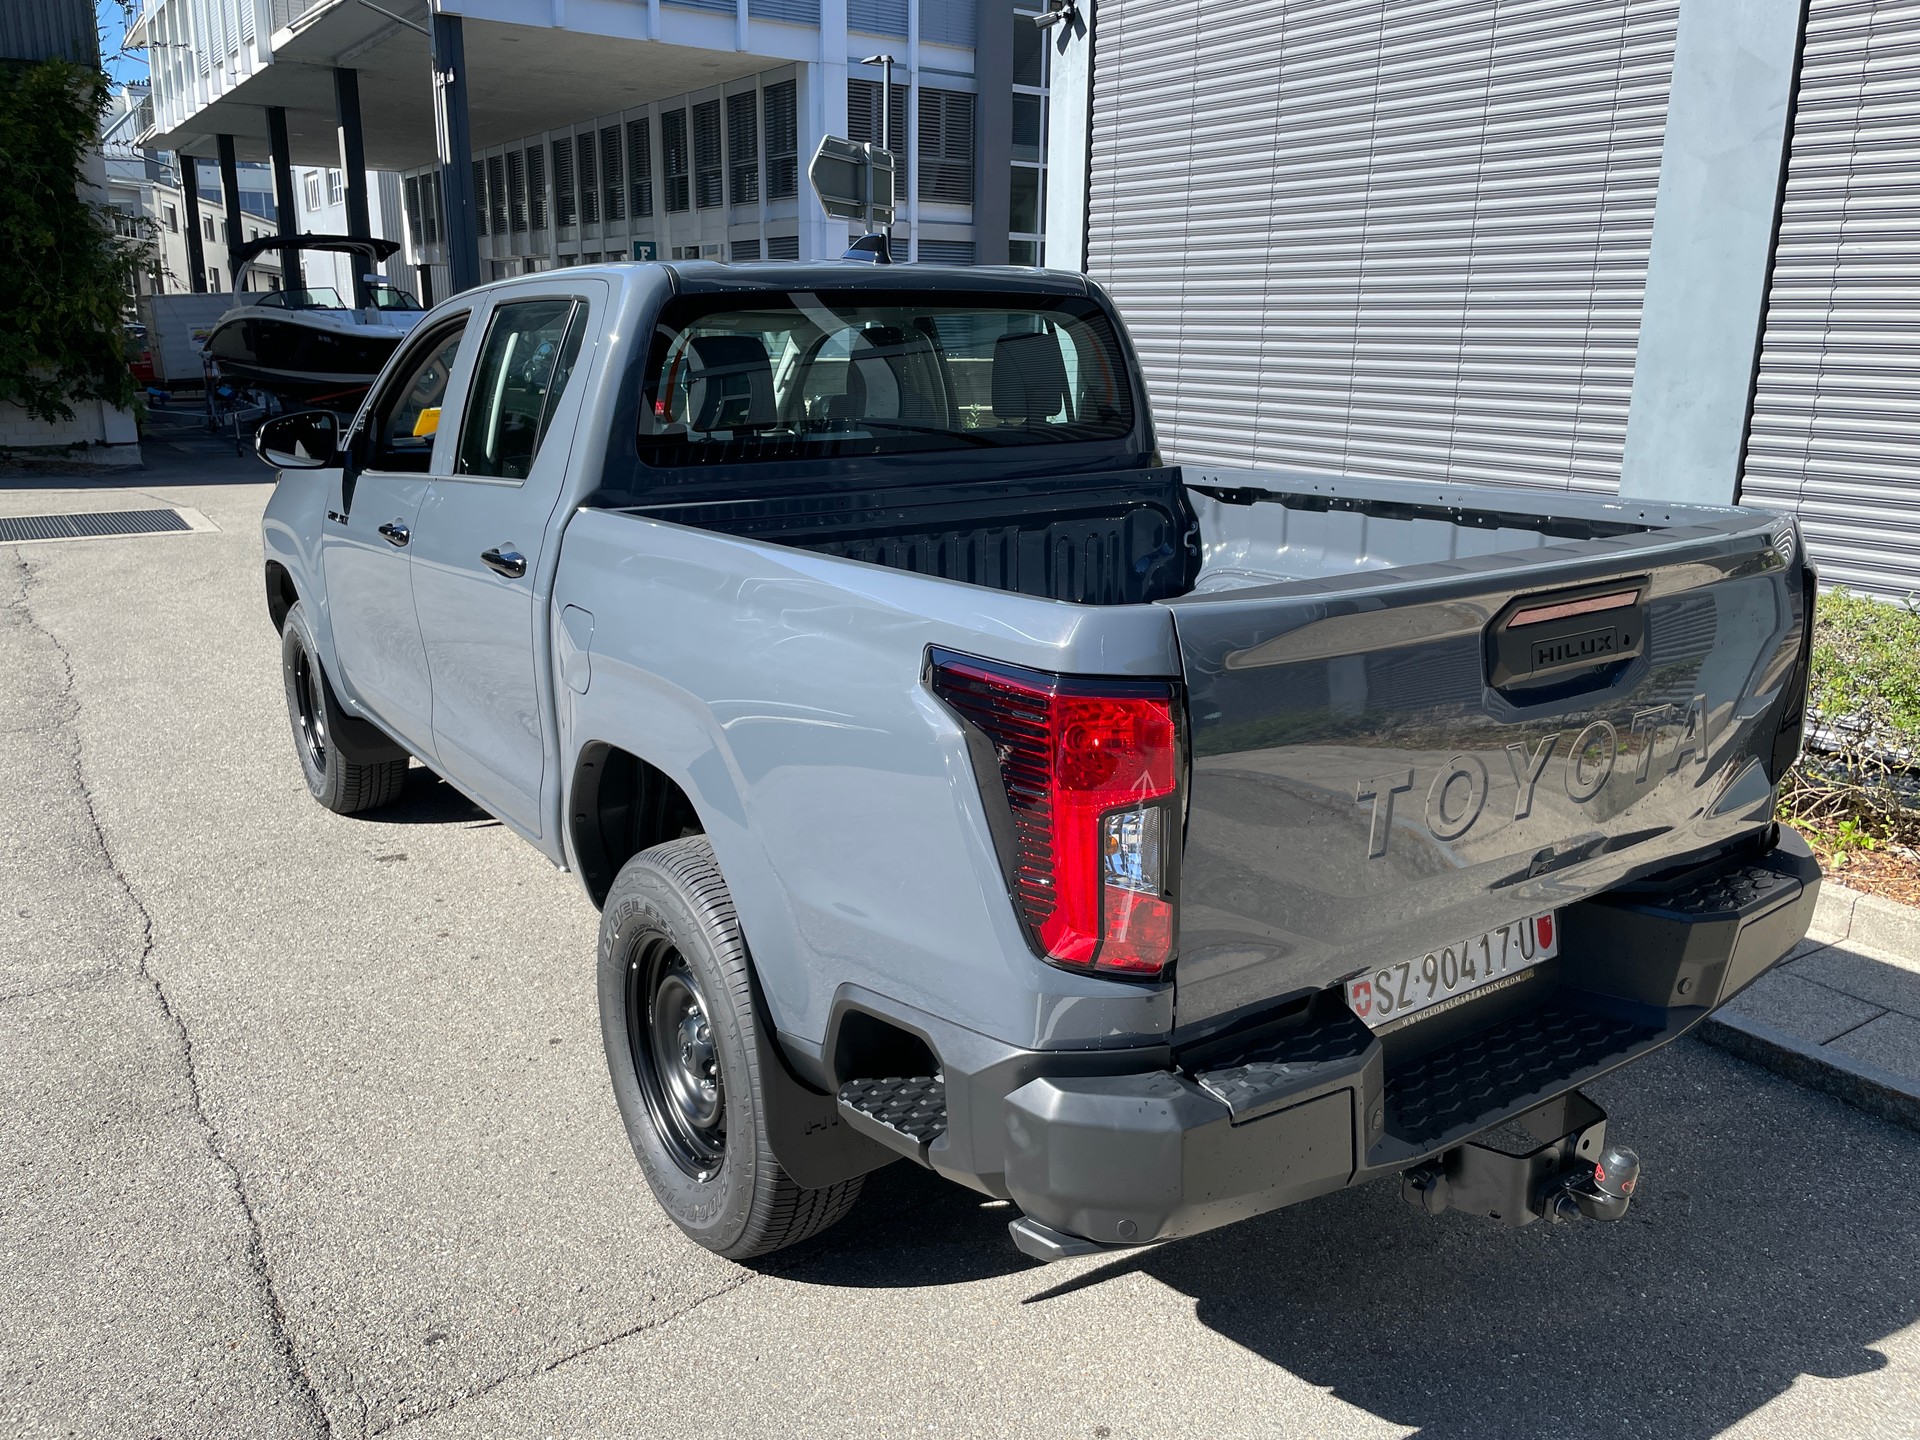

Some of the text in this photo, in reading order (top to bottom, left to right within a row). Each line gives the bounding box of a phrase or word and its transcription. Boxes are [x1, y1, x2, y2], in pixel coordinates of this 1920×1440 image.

[639, 245, 651, 261] F
[1537, 635, 1614, 665] HILUX
[1356, 694, 1709, 860] TOYOTA
